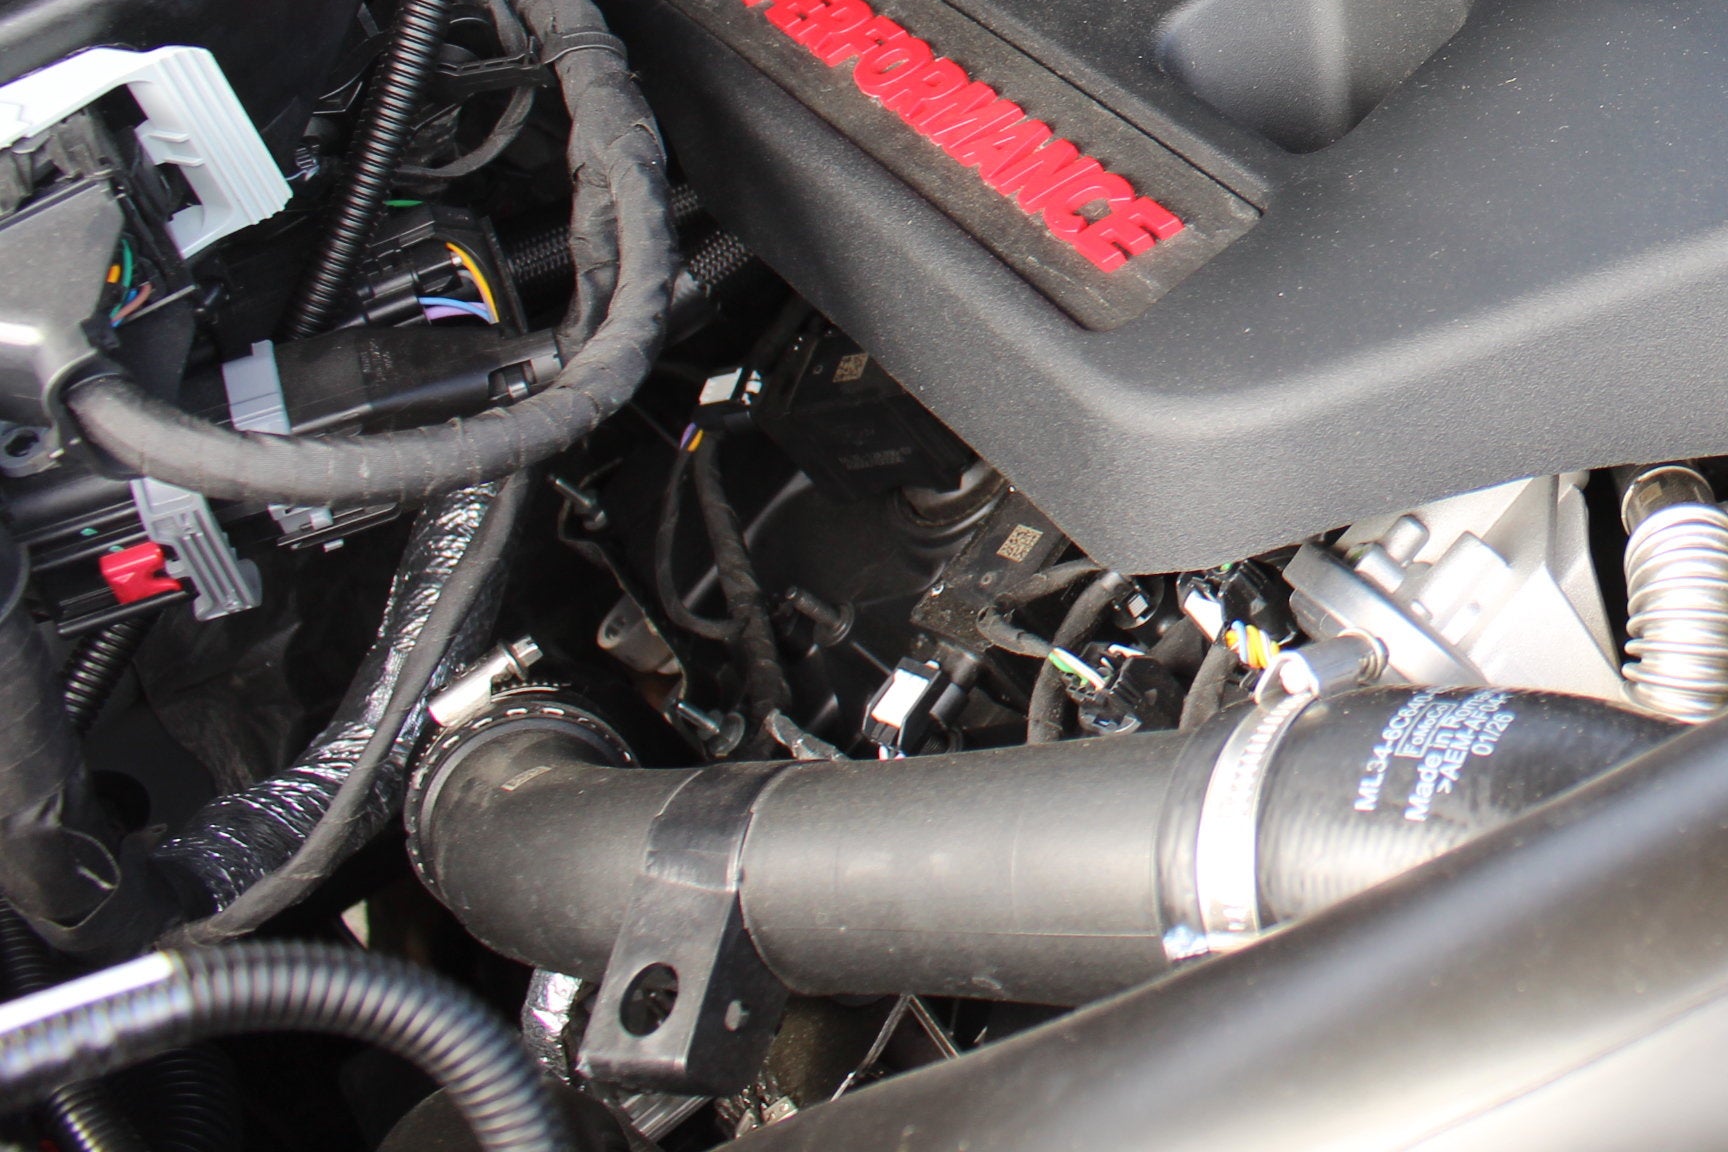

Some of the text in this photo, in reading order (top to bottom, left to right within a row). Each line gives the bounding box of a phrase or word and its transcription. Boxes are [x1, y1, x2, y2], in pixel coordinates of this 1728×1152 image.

[1401, 703, 1450, 757] FoMoCo
[1471, 710, 1516, 757] 01/26
[1405, 750, 1442, 822] Made
